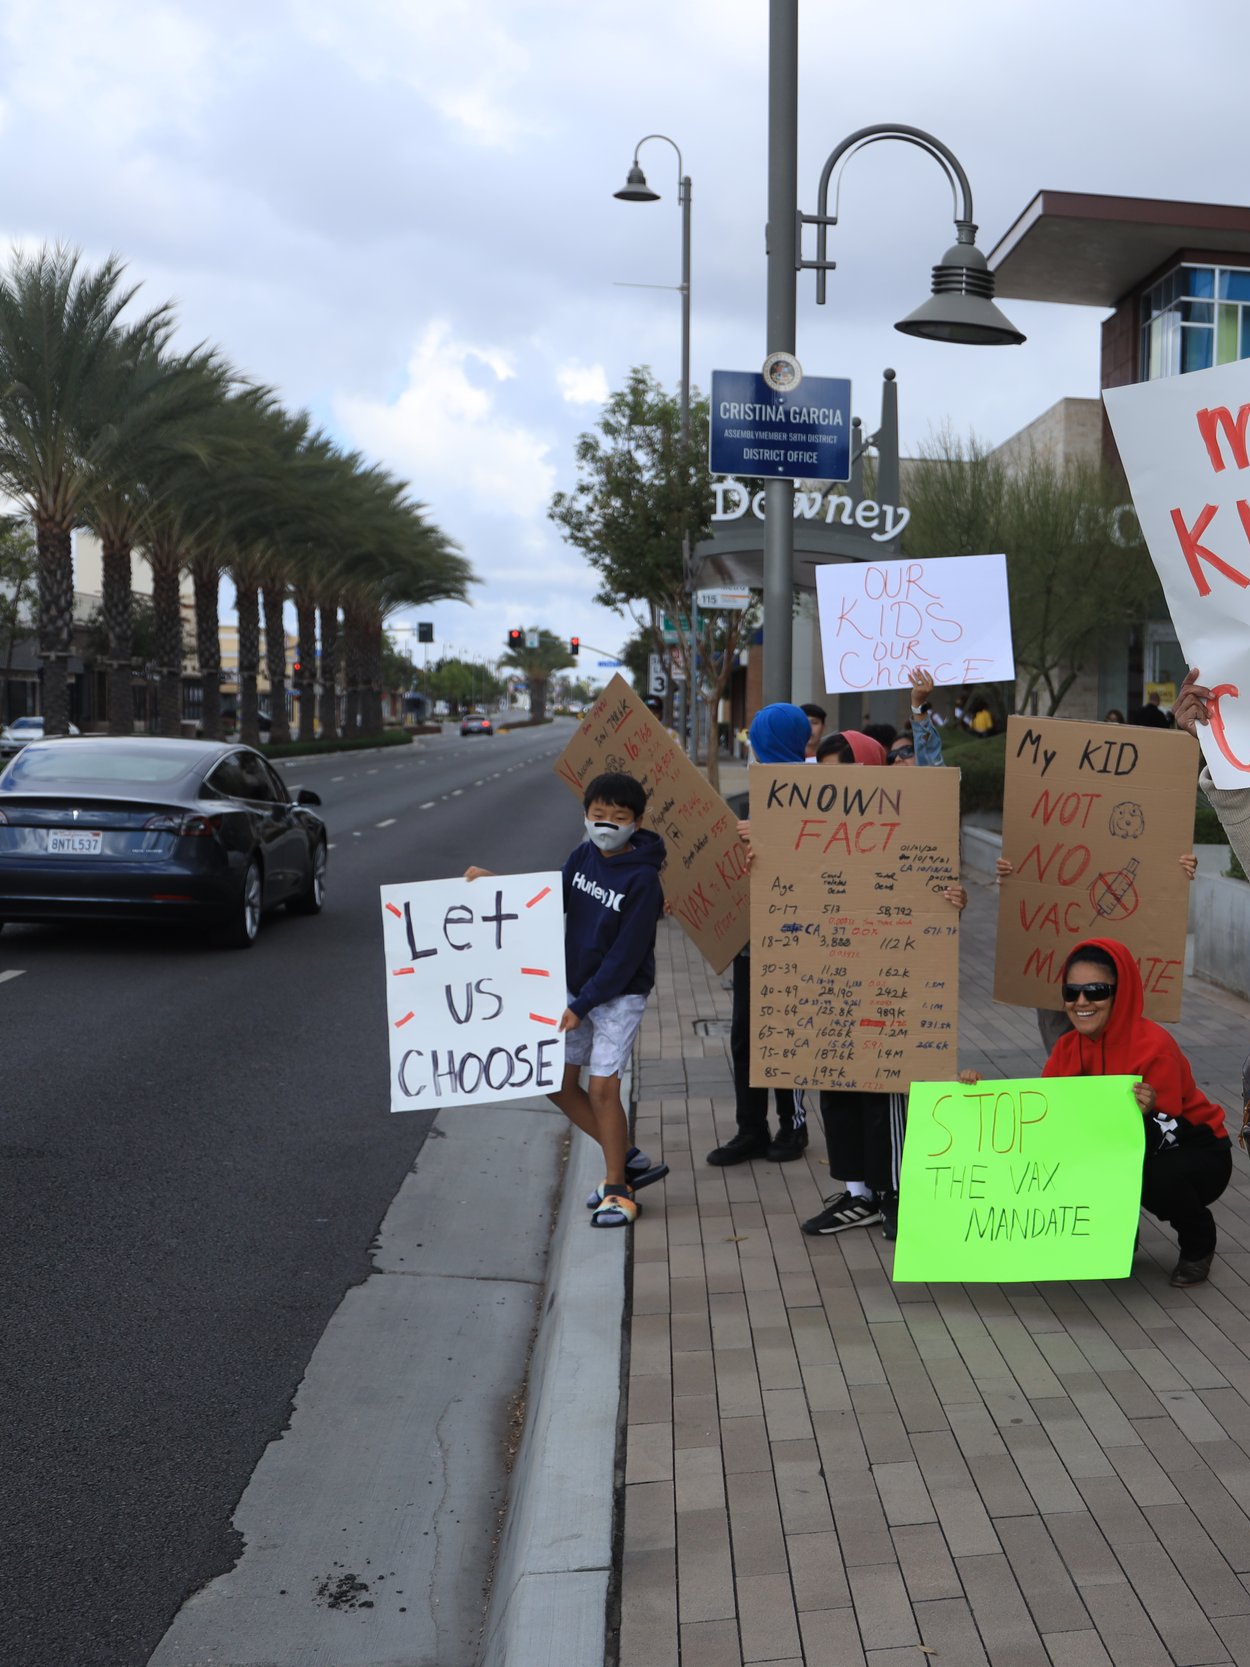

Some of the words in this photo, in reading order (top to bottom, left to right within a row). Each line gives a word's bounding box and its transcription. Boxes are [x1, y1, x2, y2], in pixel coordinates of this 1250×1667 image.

[719, 402, 786, 423] CRISTINA
[789, 406, 843, 426] GARCIA
[723, 429, 787, 441] ASSEMBLYMEMBER
[788, 433, 806, 442] 58TH
[807, 435, 838, 444] DISTRICT
[743, 448, 784, 461] DISTRICT
[787, 451, 818, 464] OFFICE
[864, 563, 940, 600] OUR
[836, 597, 963, 643] KIDS
[873, 640, 928, 661] OUR
[1078, 739, 1139, 776] KID
[767, 779, 902, 816] KNOWN
[1030, 788, 1102, 830] NOT
[52, 838, 98, 851] 8NTL537
[794, 819, 902, 856] FACT
[900, 864, 912, 872] CA
[1015, 843, 1092, 887] NO
[572, 871, 608, 904] Hurley
[771, 876, 795, 896] Age
[678, 882, 715, 931] VAX
[768, 904, 798, 915] 0-17
[821, 904, 840, 914] 513
[403, 890, 518, 961] Let
[1019, 899, 1082, 936] VAC
[805, 923, 821, 937] CA
[832, 926, 846, 935] 37
[761, 935, 799, 947] 18-29
[761, 963, 798, 976] 30-39
[801, 974, 814, 983] CA
[760, 984, 798, 998] 40-49
[760, 1004, 798, 1017] 50-64
[758, 1024, 795, 1040] 65-74
[796, 1016, 814, 1029] CA
[760, 1046, 797, 1060] 75-84
[877, 1049, 903, 1059] 1.4M
[794, 1038, 809, 1049] CA
[397, 1038, 560, 1097] CHOOSE
[793, 1075, 808, 1086] CA
[927, 1091, 1049, 1157] STOP
[925, 1164, 988, 1200] THE
[1009, 1161, 1060, 1195] VAX
[965, 1206, 1090, 1242] MANDATE
